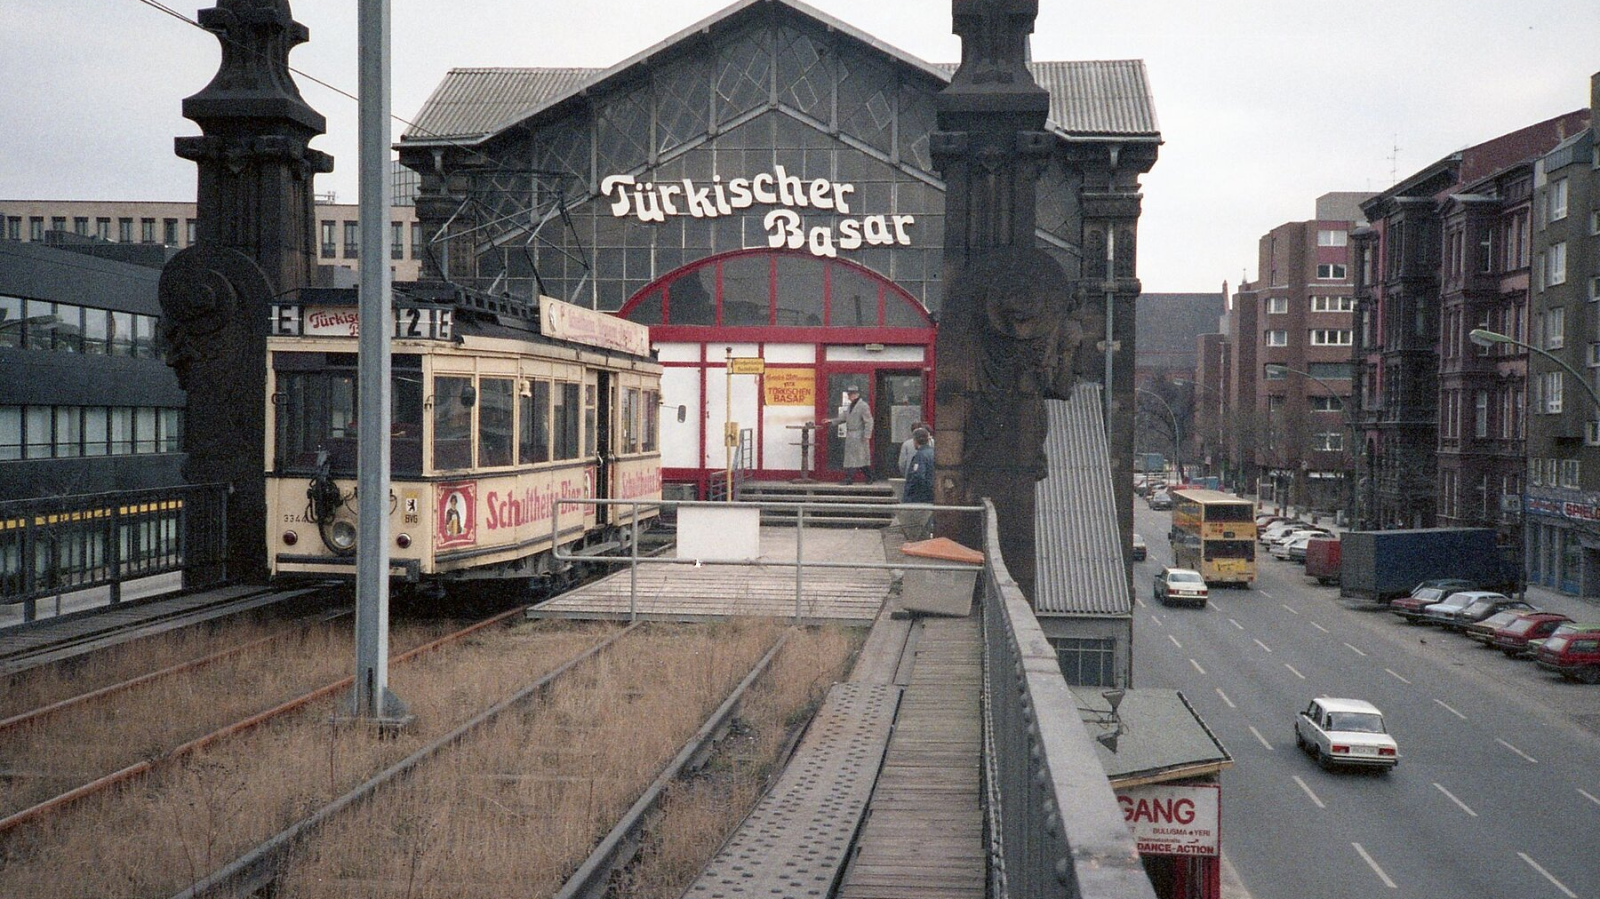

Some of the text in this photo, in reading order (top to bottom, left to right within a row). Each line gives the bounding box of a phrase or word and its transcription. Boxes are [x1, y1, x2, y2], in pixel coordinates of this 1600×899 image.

[601, 165, 854, 222] Türkischer
[764, 209, 915, 258] Basar
[278, 305, 292, 333] E
[406, 308, 422, 337] 2
[439, 309, 449, 338] E
[774, 395, 805, 403] BASAR
[404, 514, 418, 524] BVG
